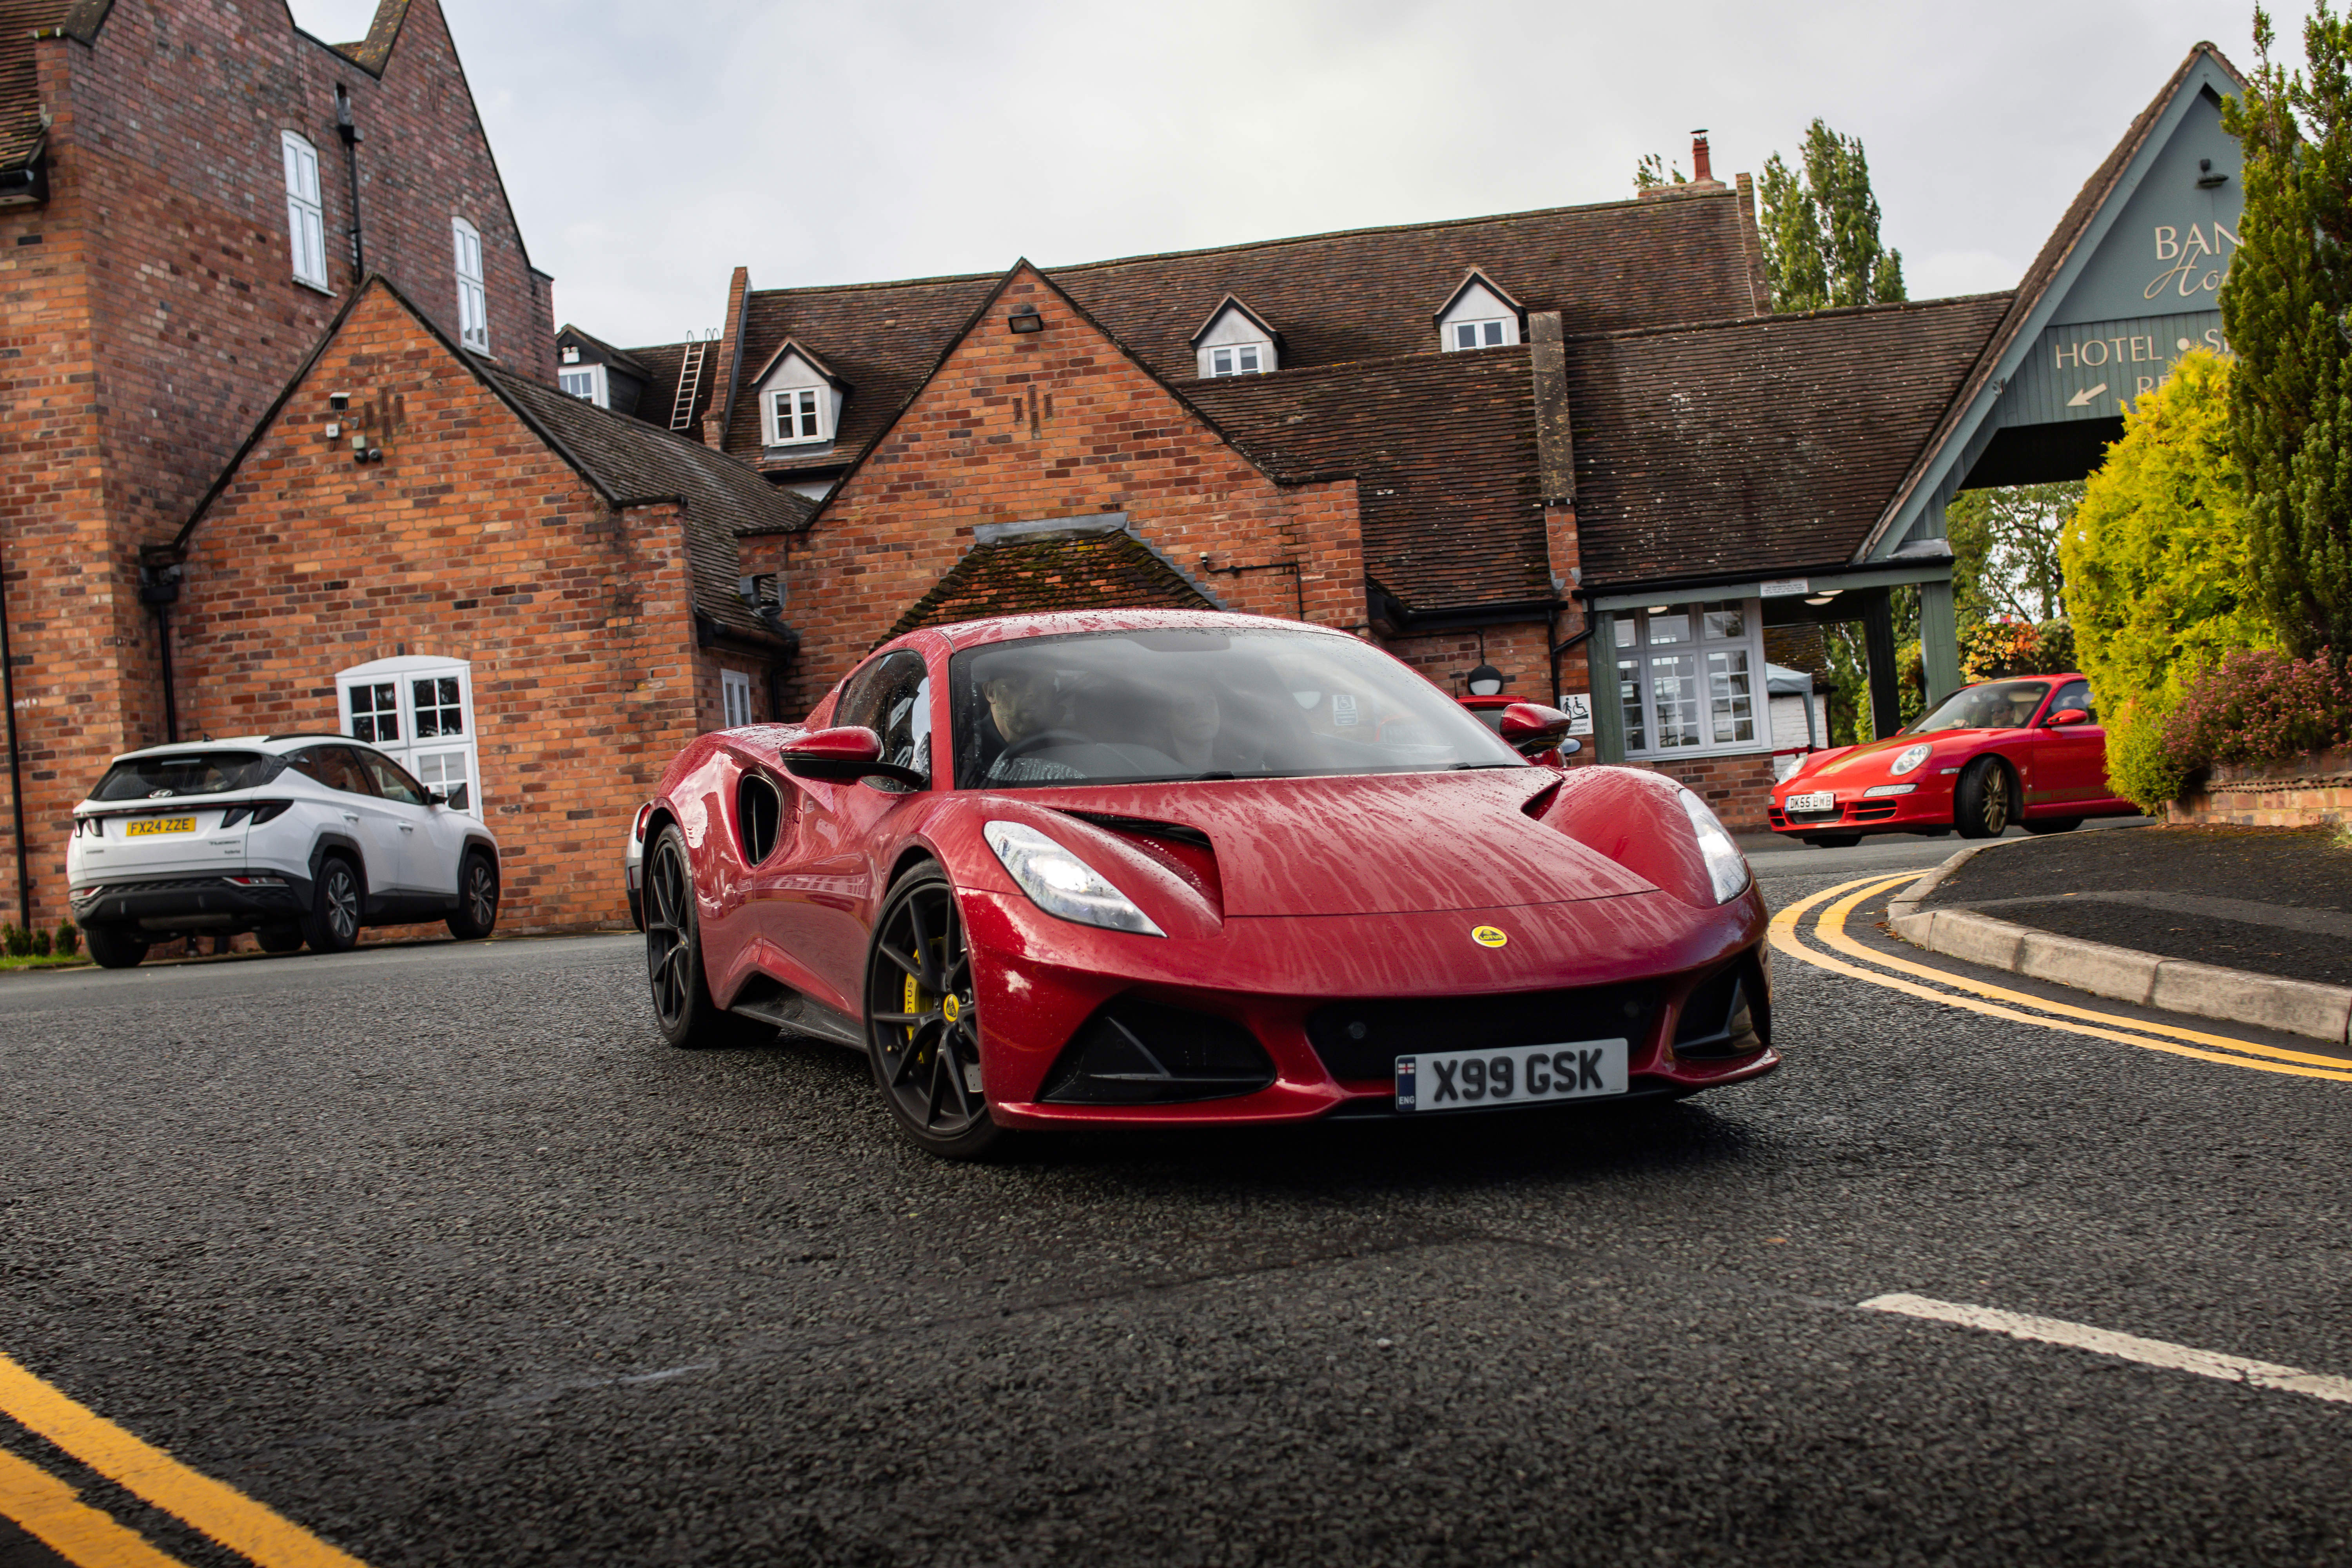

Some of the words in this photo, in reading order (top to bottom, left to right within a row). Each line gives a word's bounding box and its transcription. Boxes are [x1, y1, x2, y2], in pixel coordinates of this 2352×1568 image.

[2155, 221, 2244, 260] BAN
[2055, 336, 2163, 369] HOTEL
[1790, 797, 1810, 808] DK55
[131, 821, 161, 834] FX24
[166, 818, 190, 831] ZZE
[1433, 1056, 1513, 1102] X99
[1526, 1048, 1602, 1094] GSK
[1399, 1096, 1415, 1104] ENG
